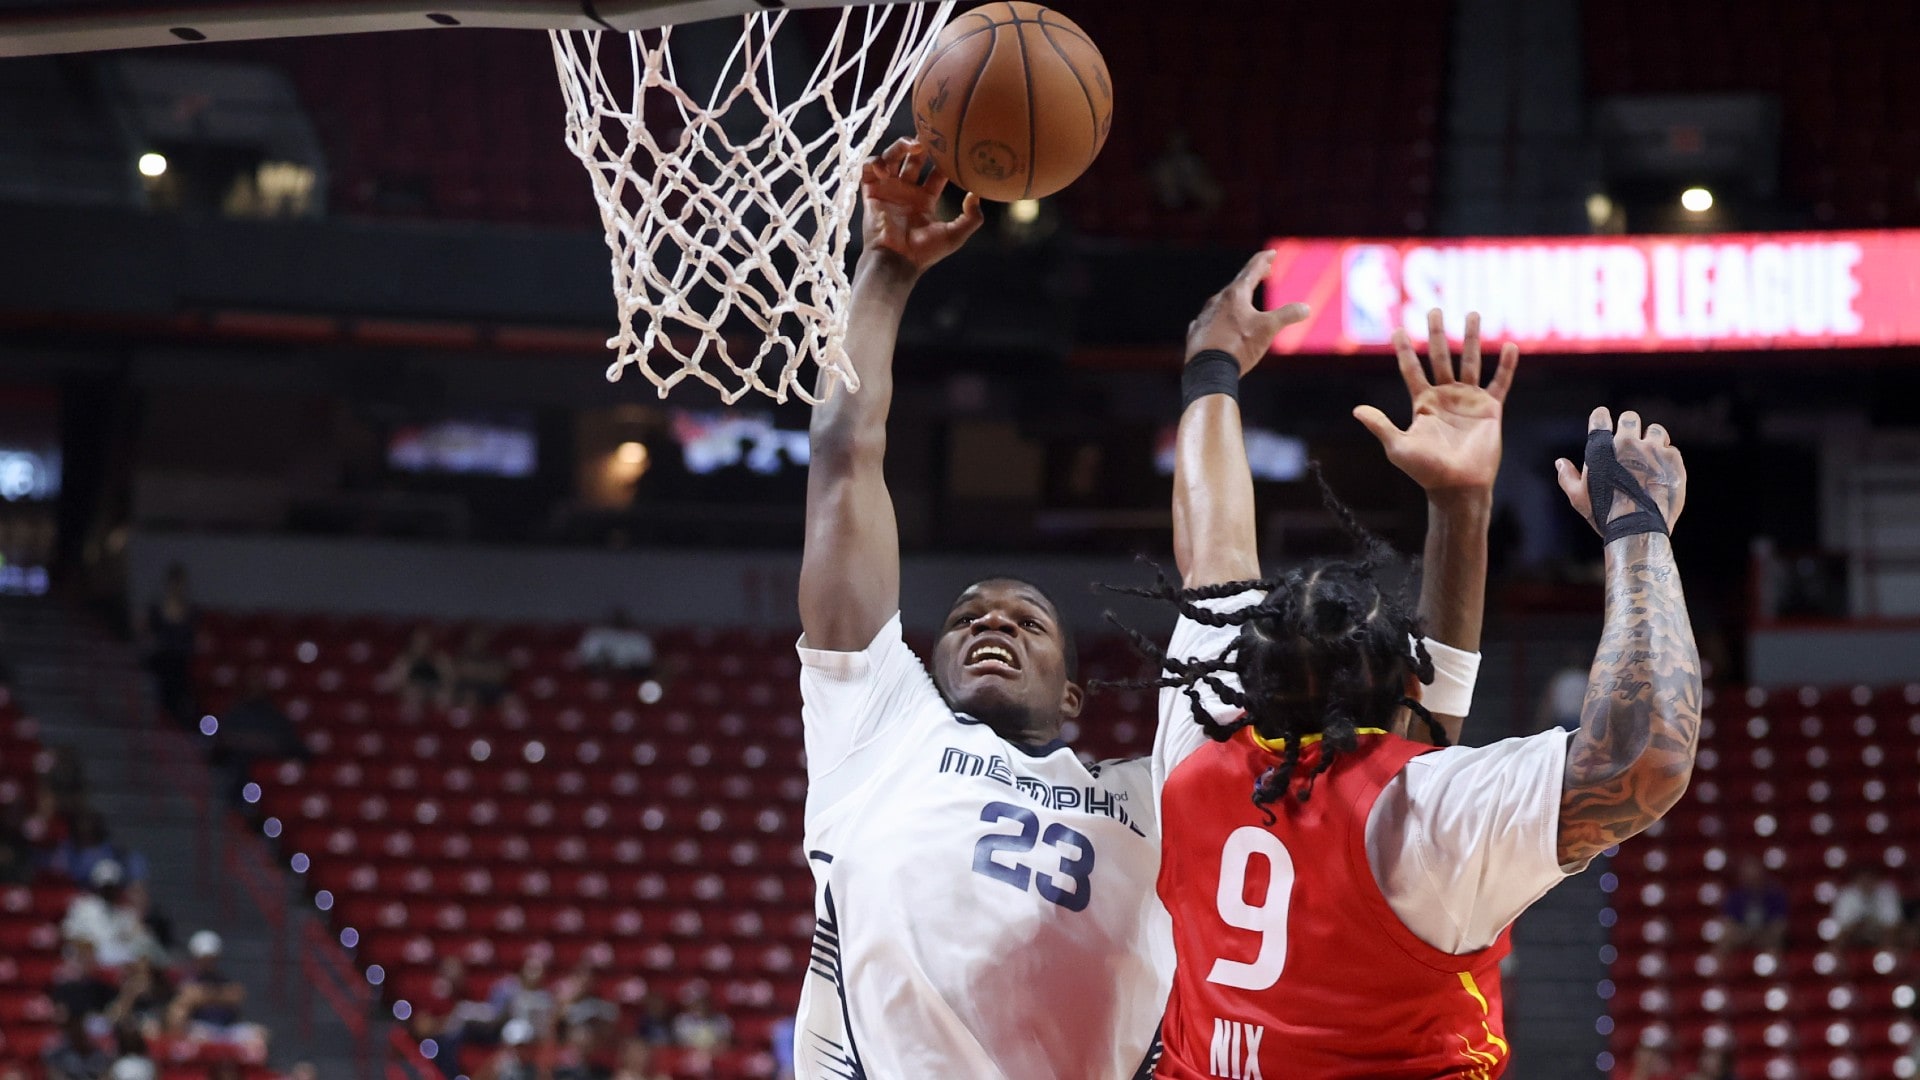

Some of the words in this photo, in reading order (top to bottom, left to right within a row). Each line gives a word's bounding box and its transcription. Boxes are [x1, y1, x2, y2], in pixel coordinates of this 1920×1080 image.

[1403, 246, 1645, 340] SUMMER
[1653, 242, 1863, 338] LEAGUE
[972, 801, 1095, 912] 23
[1205, 825, 1296, 991] 9
[1209, 1017, 1264, 1080] NIX
